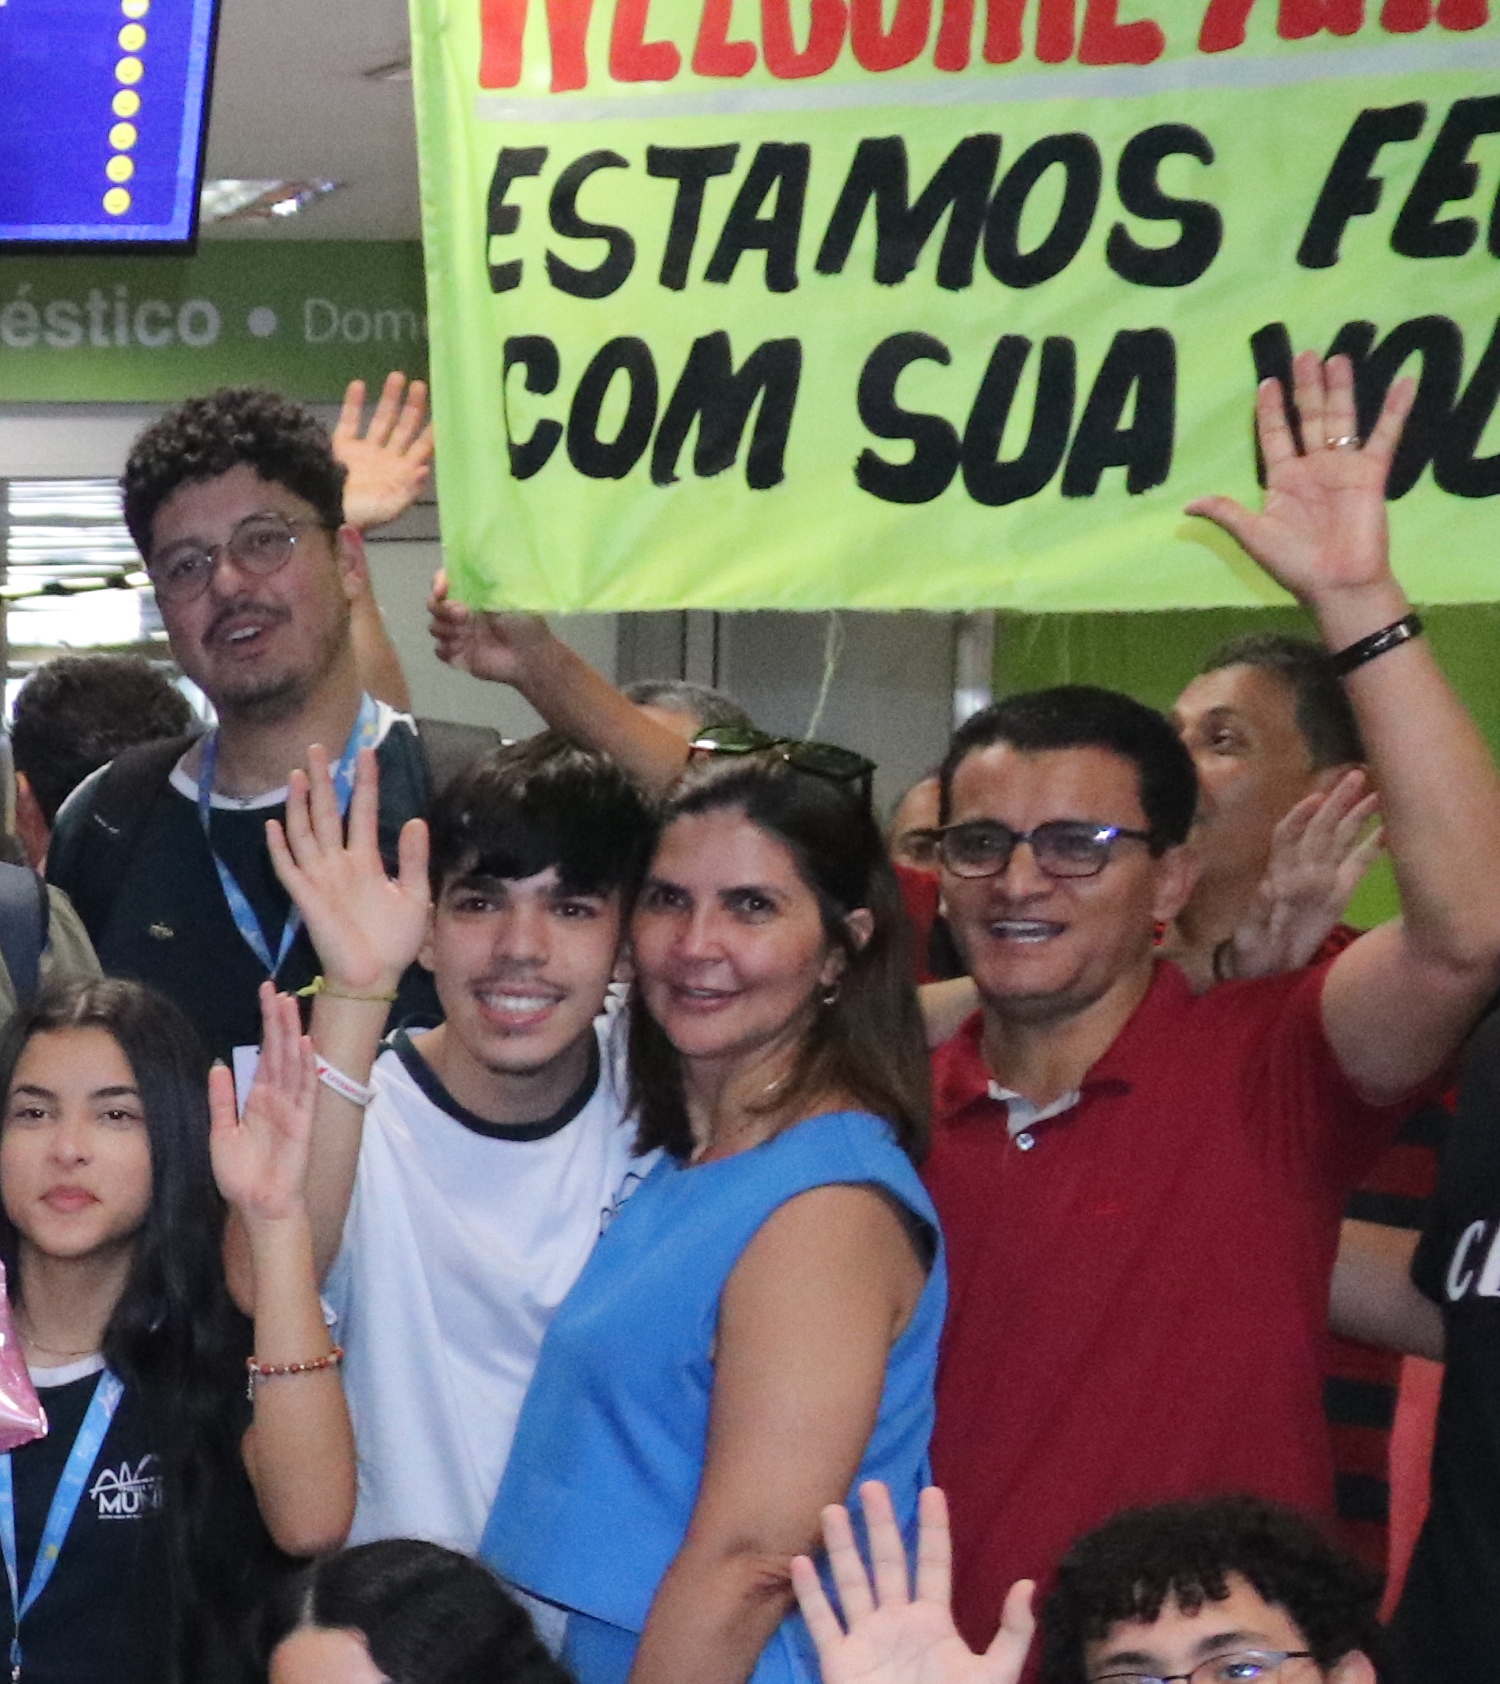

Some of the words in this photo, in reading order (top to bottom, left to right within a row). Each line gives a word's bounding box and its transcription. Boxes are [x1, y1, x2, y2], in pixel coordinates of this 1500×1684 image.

[486, 122, 1222, 299] ESTAMOS
[1296, 94, 1500, 269] FE
[501, 329, 802, 490] COM
[853, 326, 1176, 505] SUA
